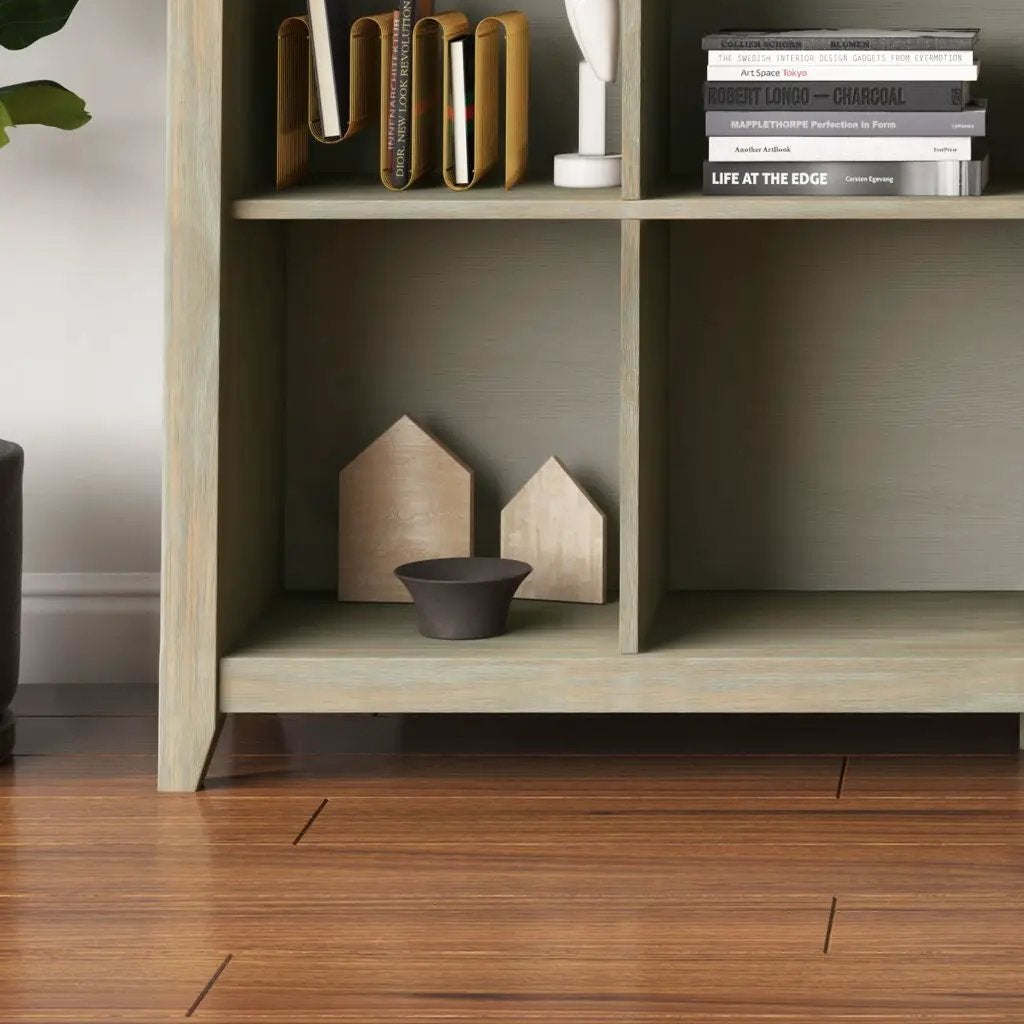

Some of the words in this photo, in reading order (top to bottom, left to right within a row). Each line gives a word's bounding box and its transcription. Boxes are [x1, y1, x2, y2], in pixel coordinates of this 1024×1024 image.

[400, 0, 412, 77] REVOLUTION
[830, 40, 870, 49] BLUMEN
[718, 54, 732, 63] THE
[738, 54, 771, 63] SWEDISH
[776, 54, 814, 63] INTERIOR
[819, 54, 848, 63] DESIGN
[852, 54, 887, 63] GADGETS
[891, 54, 911, 63] FROM
[914, 54, 963, 63] EVERMOTION
[740, 69, 754, 77] Art
[756, 69, 781, 78] Space
[783, 69, 808, 78] Tokyo
[399, 79, 408, 113] LOOK
[708, 87, 762, 106] ROBERT
[765, 87, 810, 106] LONGO
[833, 87, 906, 106] CHARCOAL
[397, 115, 407, 143] NEW
[730, 120, 808, 129] MAPPLETHORPE
[811, 120, 859, 129] Perfection
[872, 120, 896, 129] Form
[712, 172, 740, 185] LIFE
[742, 172, 760, 185] AT
[762, 172, 788, 185] THE
[791, 172, 828, 185] EDGE
